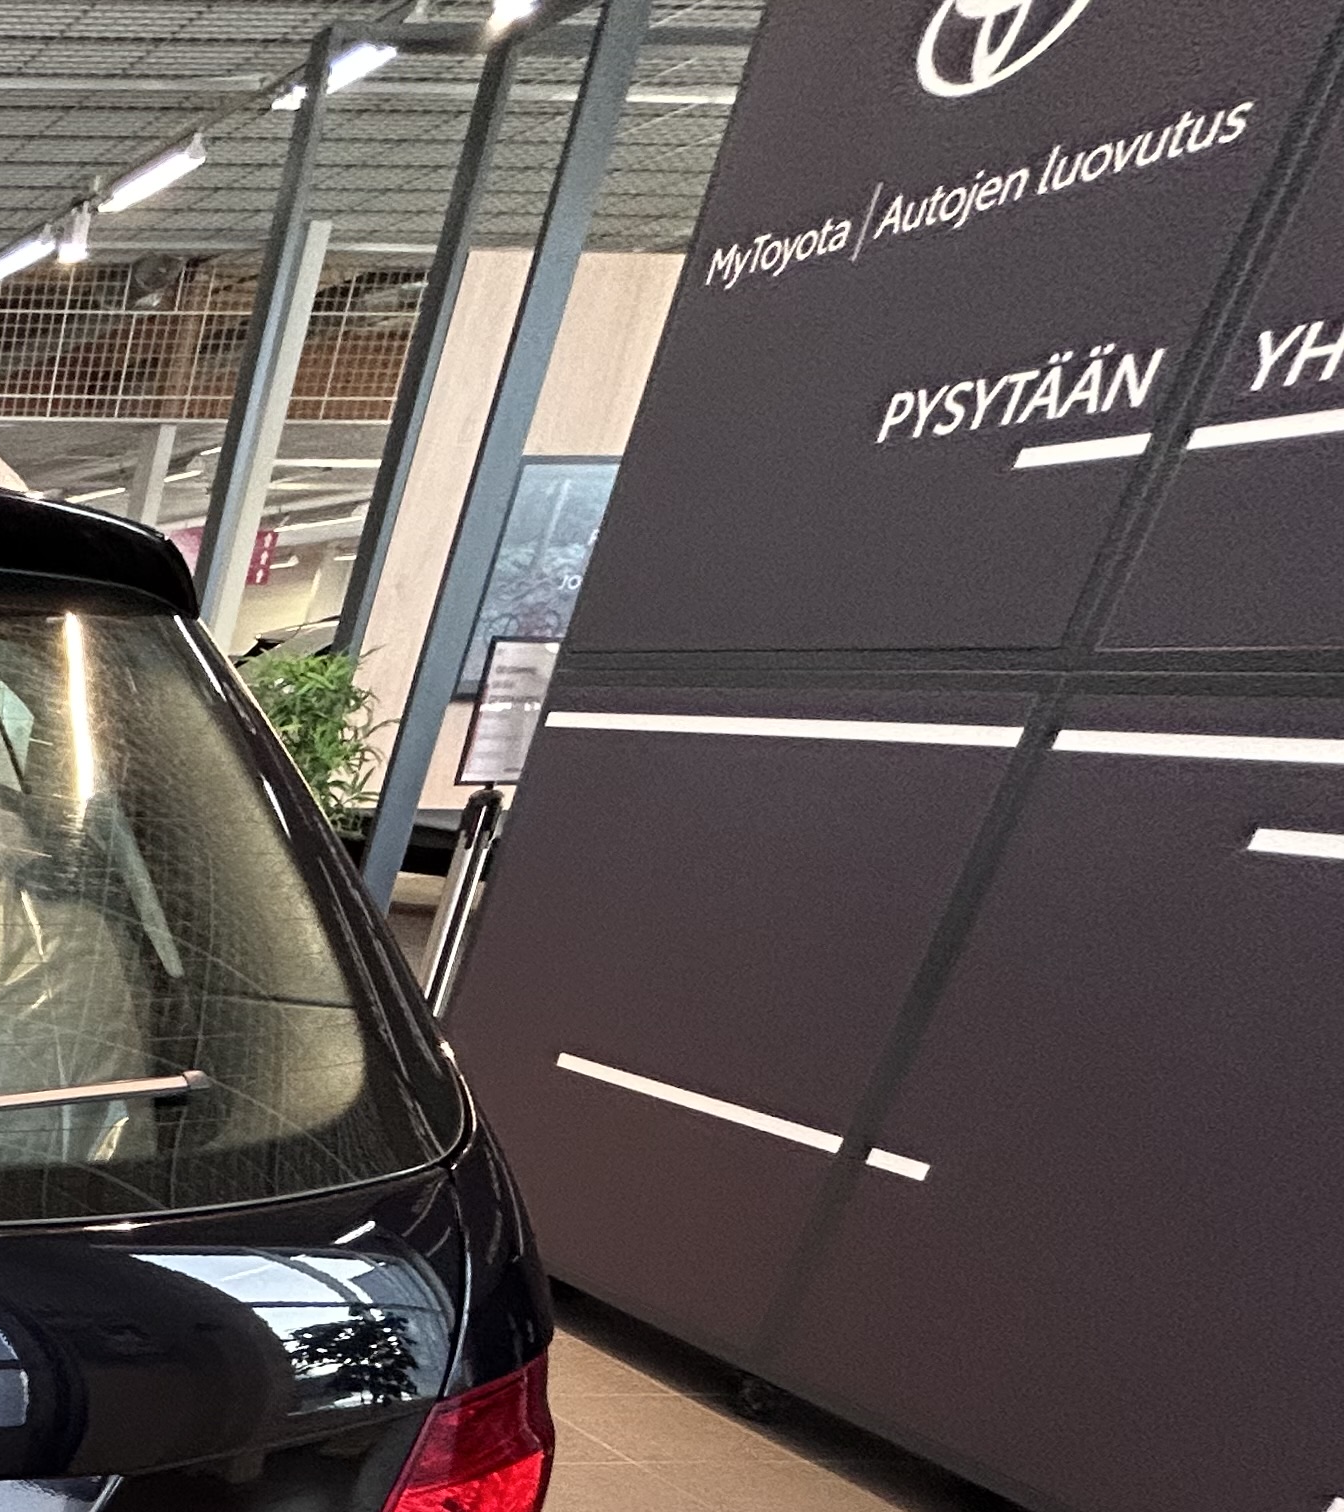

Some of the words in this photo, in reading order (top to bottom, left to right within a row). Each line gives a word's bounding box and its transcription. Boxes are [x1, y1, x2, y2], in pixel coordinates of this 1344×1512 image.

[706, 217, 851, 289] MyToyota
[873, 166, 1030, 230] Autojen
[1037, 101, 1255, 195] luovutus
[876, 343, 1167, 443] PYSYTÄÄN
[1250, 321, 1344, 391] YH
